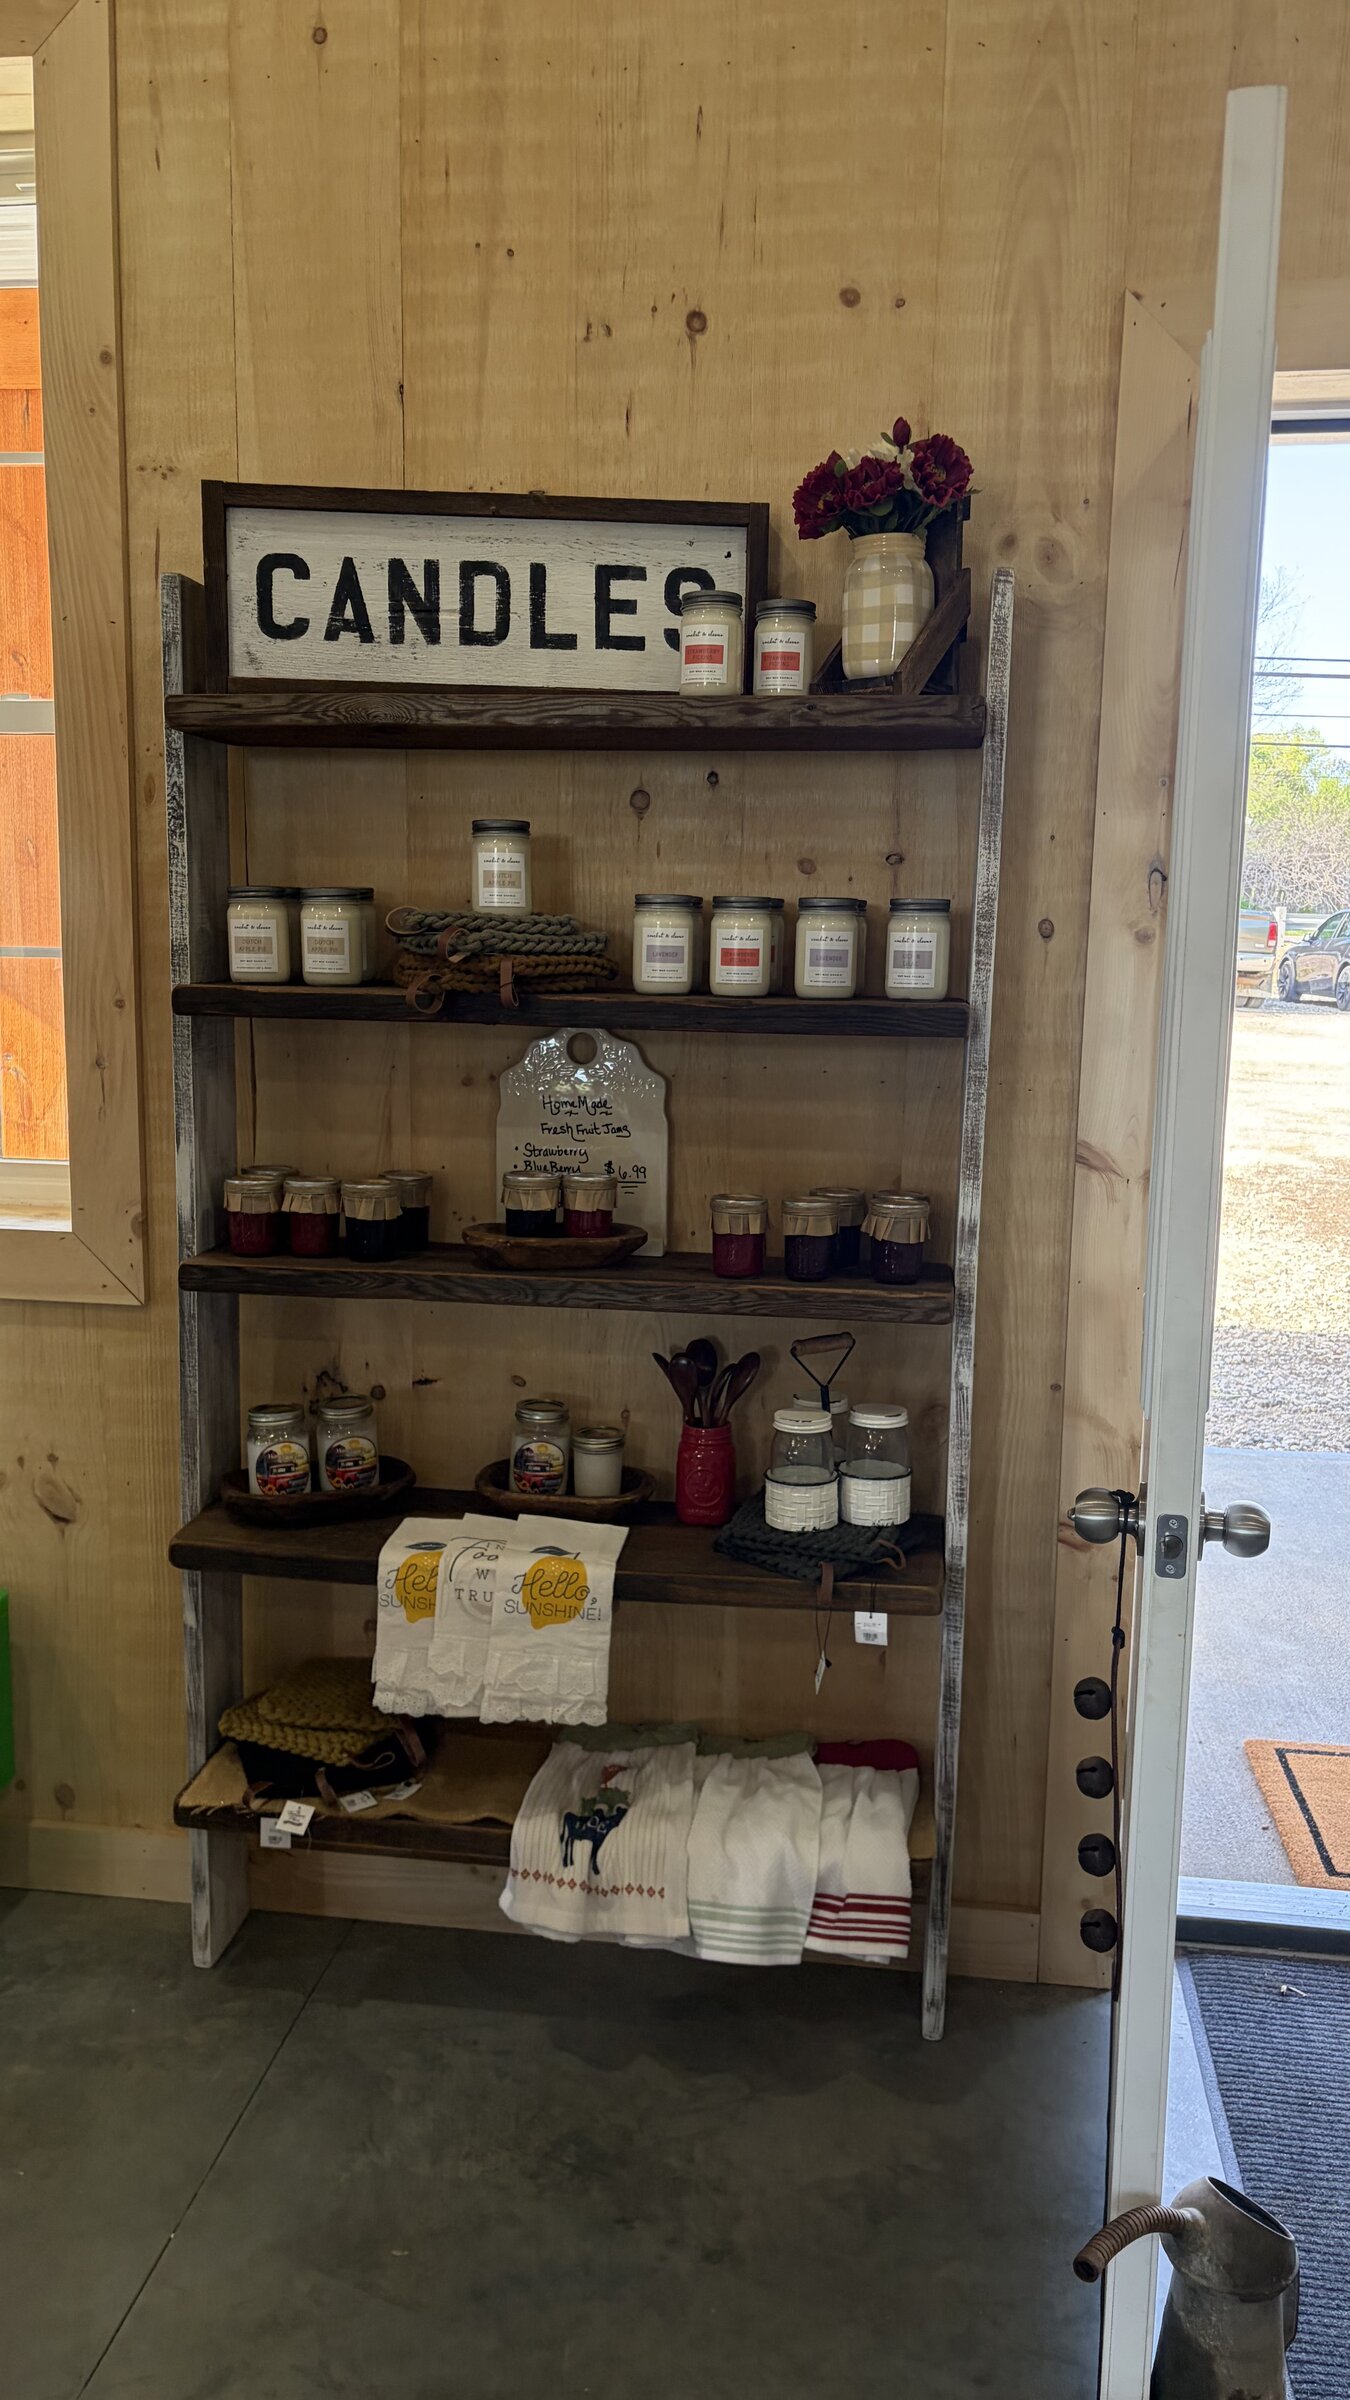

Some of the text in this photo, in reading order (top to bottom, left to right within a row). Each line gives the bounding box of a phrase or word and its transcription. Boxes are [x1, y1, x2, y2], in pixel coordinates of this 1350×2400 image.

[540, 1121, 632, 1142] Fresh Fruit Jams
[523, 1142, 589, 1164] Strawberry
[503, 1598, 602, 1621] SUNSHINE!
